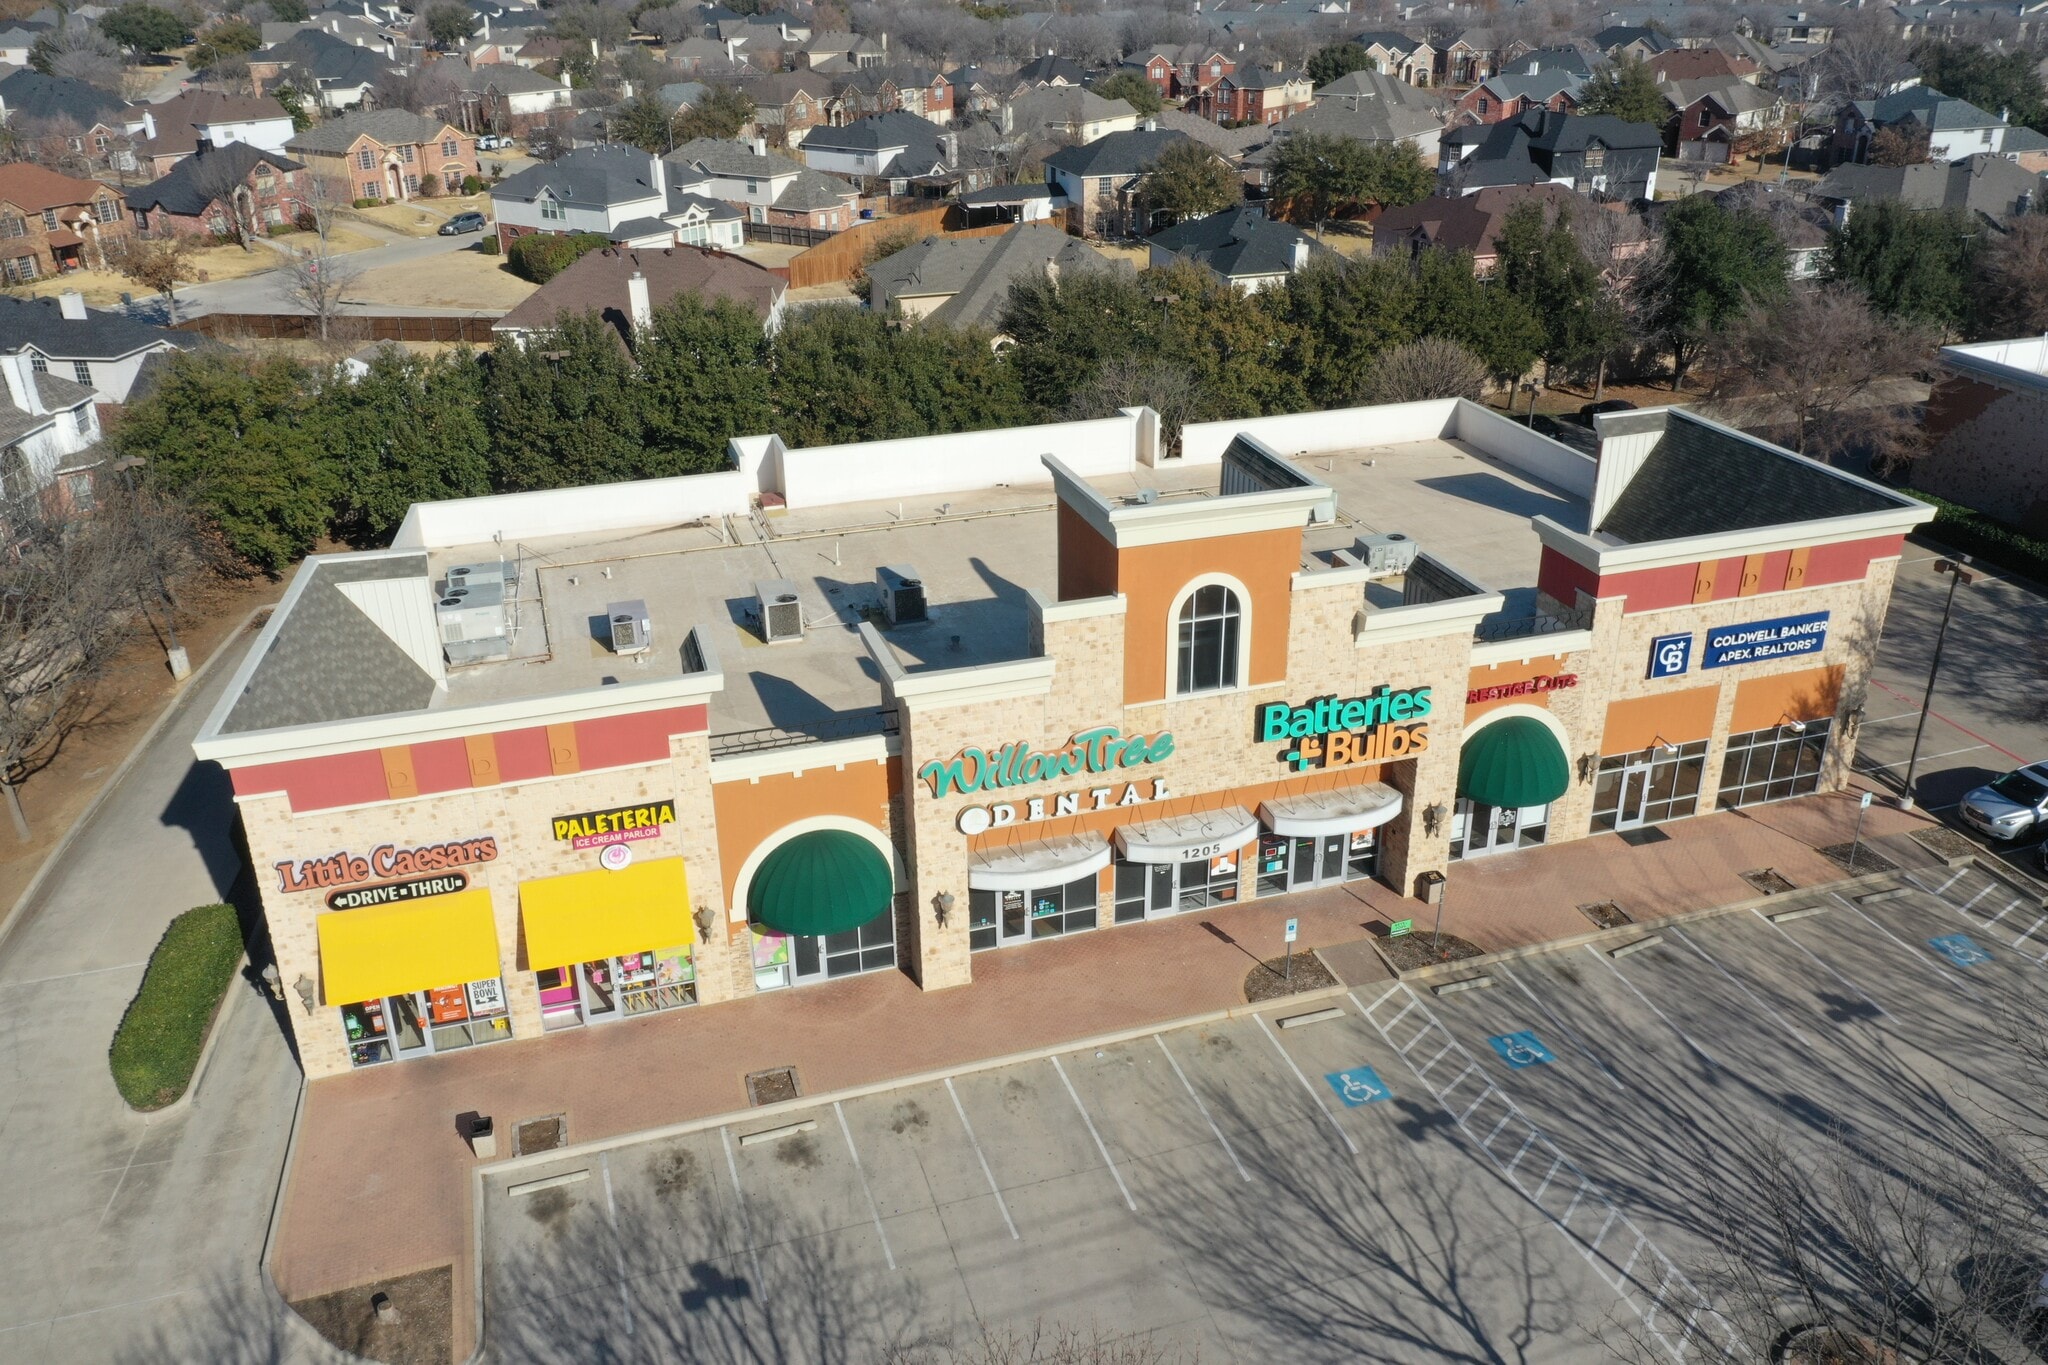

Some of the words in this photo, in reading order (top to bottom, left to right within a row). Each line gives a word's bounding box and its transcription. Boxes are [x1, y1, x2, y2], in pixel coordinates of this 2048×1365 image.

[1713, 629, 1778, 648] COLDWELL
[1780, 621, 1828, 638] BANKER
[1263, 687, 1432, 742] Batteries
[1325, 723, 1428, 768] Bulbs
[991, 779, 1168, 827] DENTAL
[554, 805, 674, 840] PALETERIA
[576, 838, 590, 847] ICE
[592, 833, 622, 844] CREAM
[623, 828, 657, 840] PARLOR
[277, 858, 369, 891] Little
[371, 837, 498, 877] Caesars
[1182, 843, 1220, 859] 1205
[472, 979, 496, 991] SUPER
[473, 988, 498, 999] BOWL
